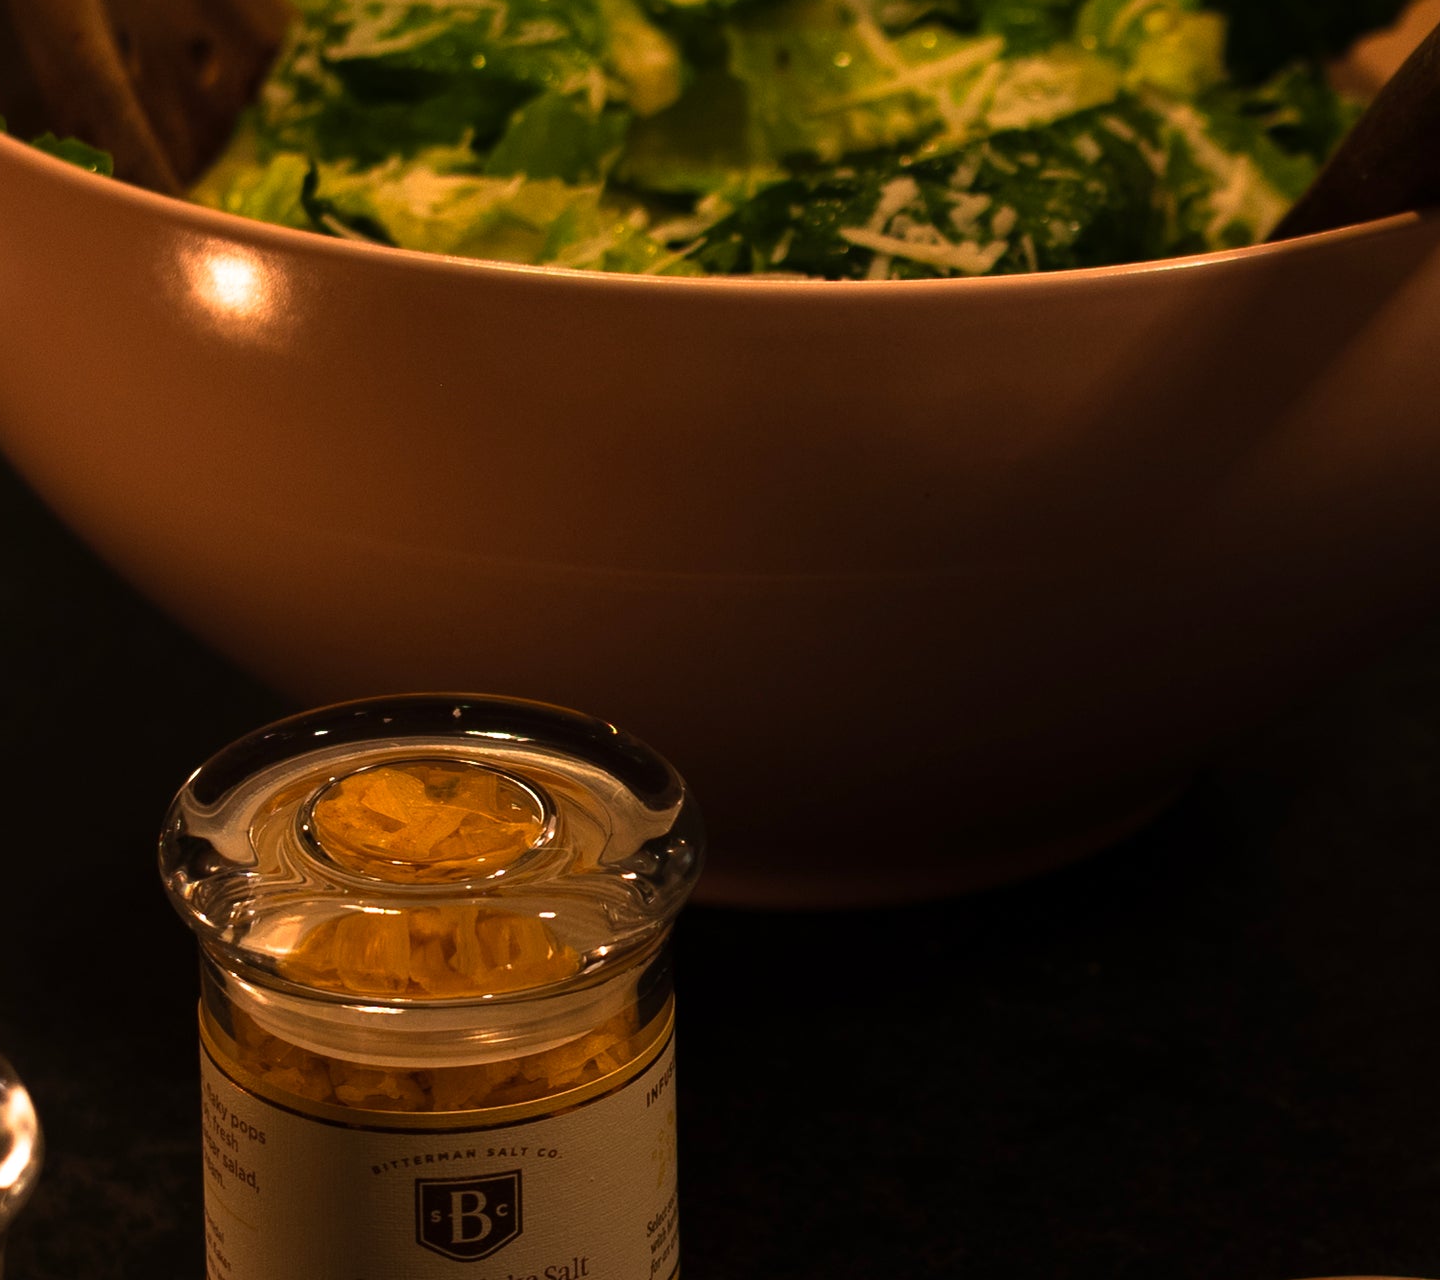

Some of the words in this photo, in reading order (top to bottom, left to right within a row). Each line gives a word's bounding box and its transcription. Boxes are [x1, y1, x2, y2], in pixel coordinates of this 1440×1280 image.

[212, 1115, 239, 1152] fresh
[230, 1113, 266, 1145] pops
[223, 1153, 260, 1193] salad,
[371, 1148, 477, 1176] BITTERMAN
[486, 1146, 530, 1158] SALT
[536, 1147, 564, 1160] CO.
[448, 1189, 493, 1245] B
